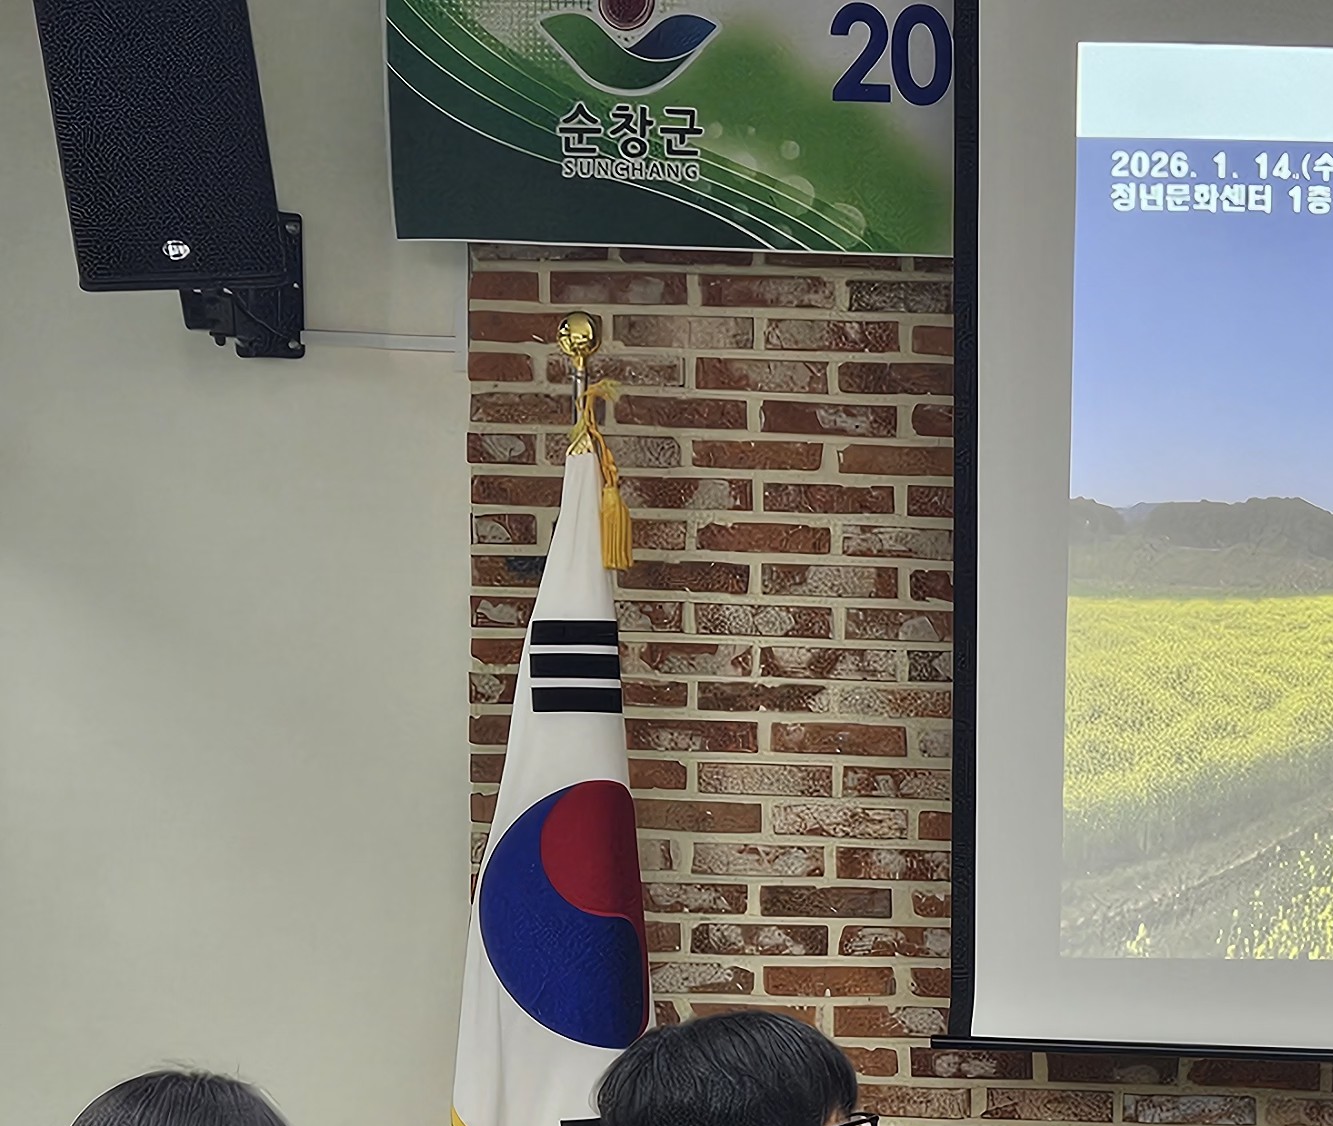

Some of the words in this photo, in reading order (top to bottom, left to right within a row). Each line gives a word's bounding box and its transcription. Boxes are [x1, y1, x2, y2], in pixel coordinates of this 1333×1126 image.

[557, 102, 703, 158] 순창군
[561, 157, 700, 181] SUNCHANG
[1110, 150, 1197, 179] 2026.
[1288, 185, 1332, 214] 1층
